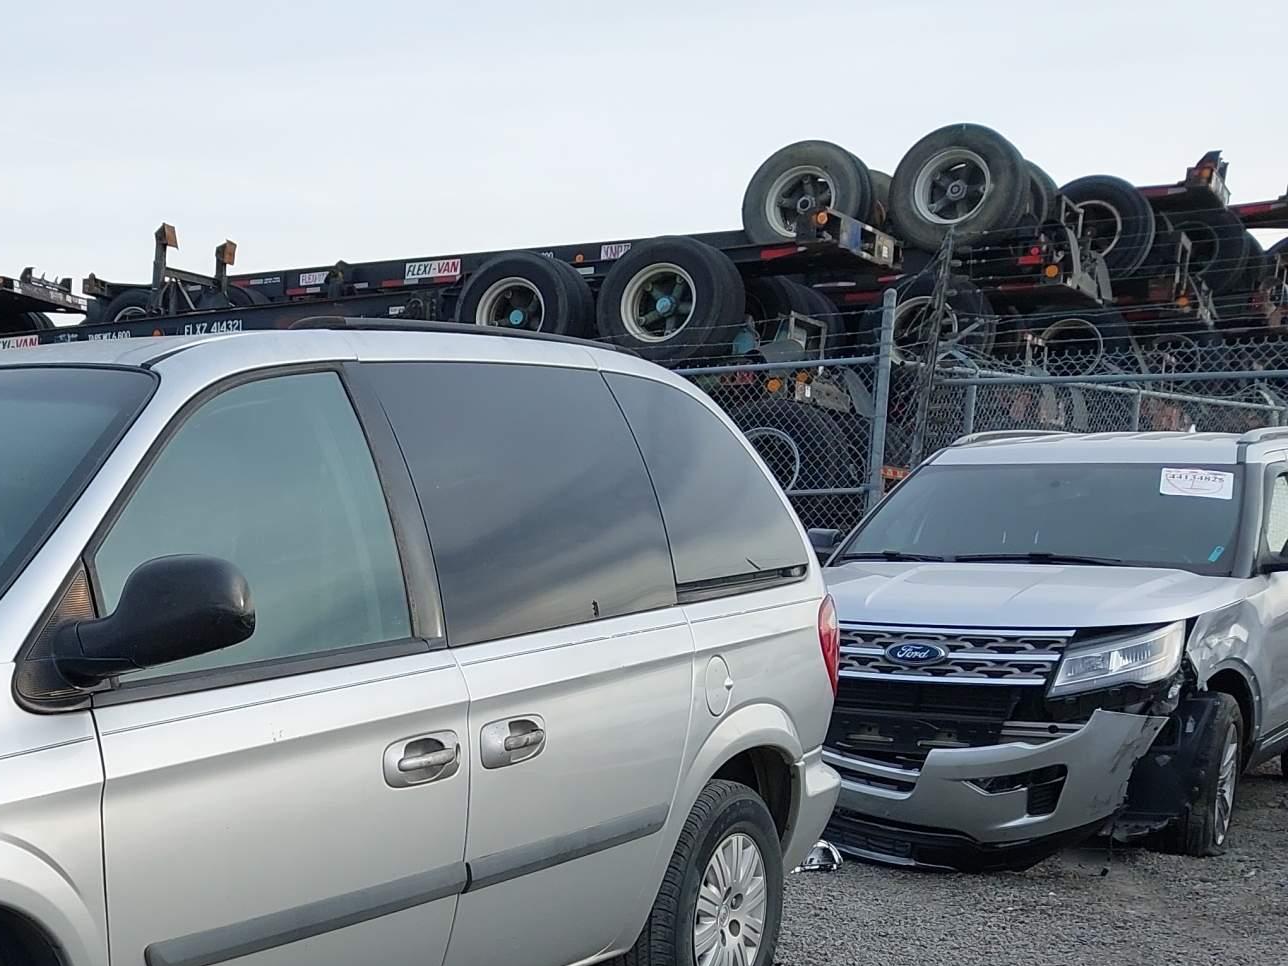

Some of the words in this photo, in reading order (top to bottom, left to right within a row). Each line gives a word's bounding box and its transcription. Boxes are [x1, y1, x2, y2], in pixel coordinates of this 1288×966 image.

[407, 260, 459, 277] FLEXI-VAN
[210, 319, 242, 334] 414321
[897, 645, 930, 659] Ford
